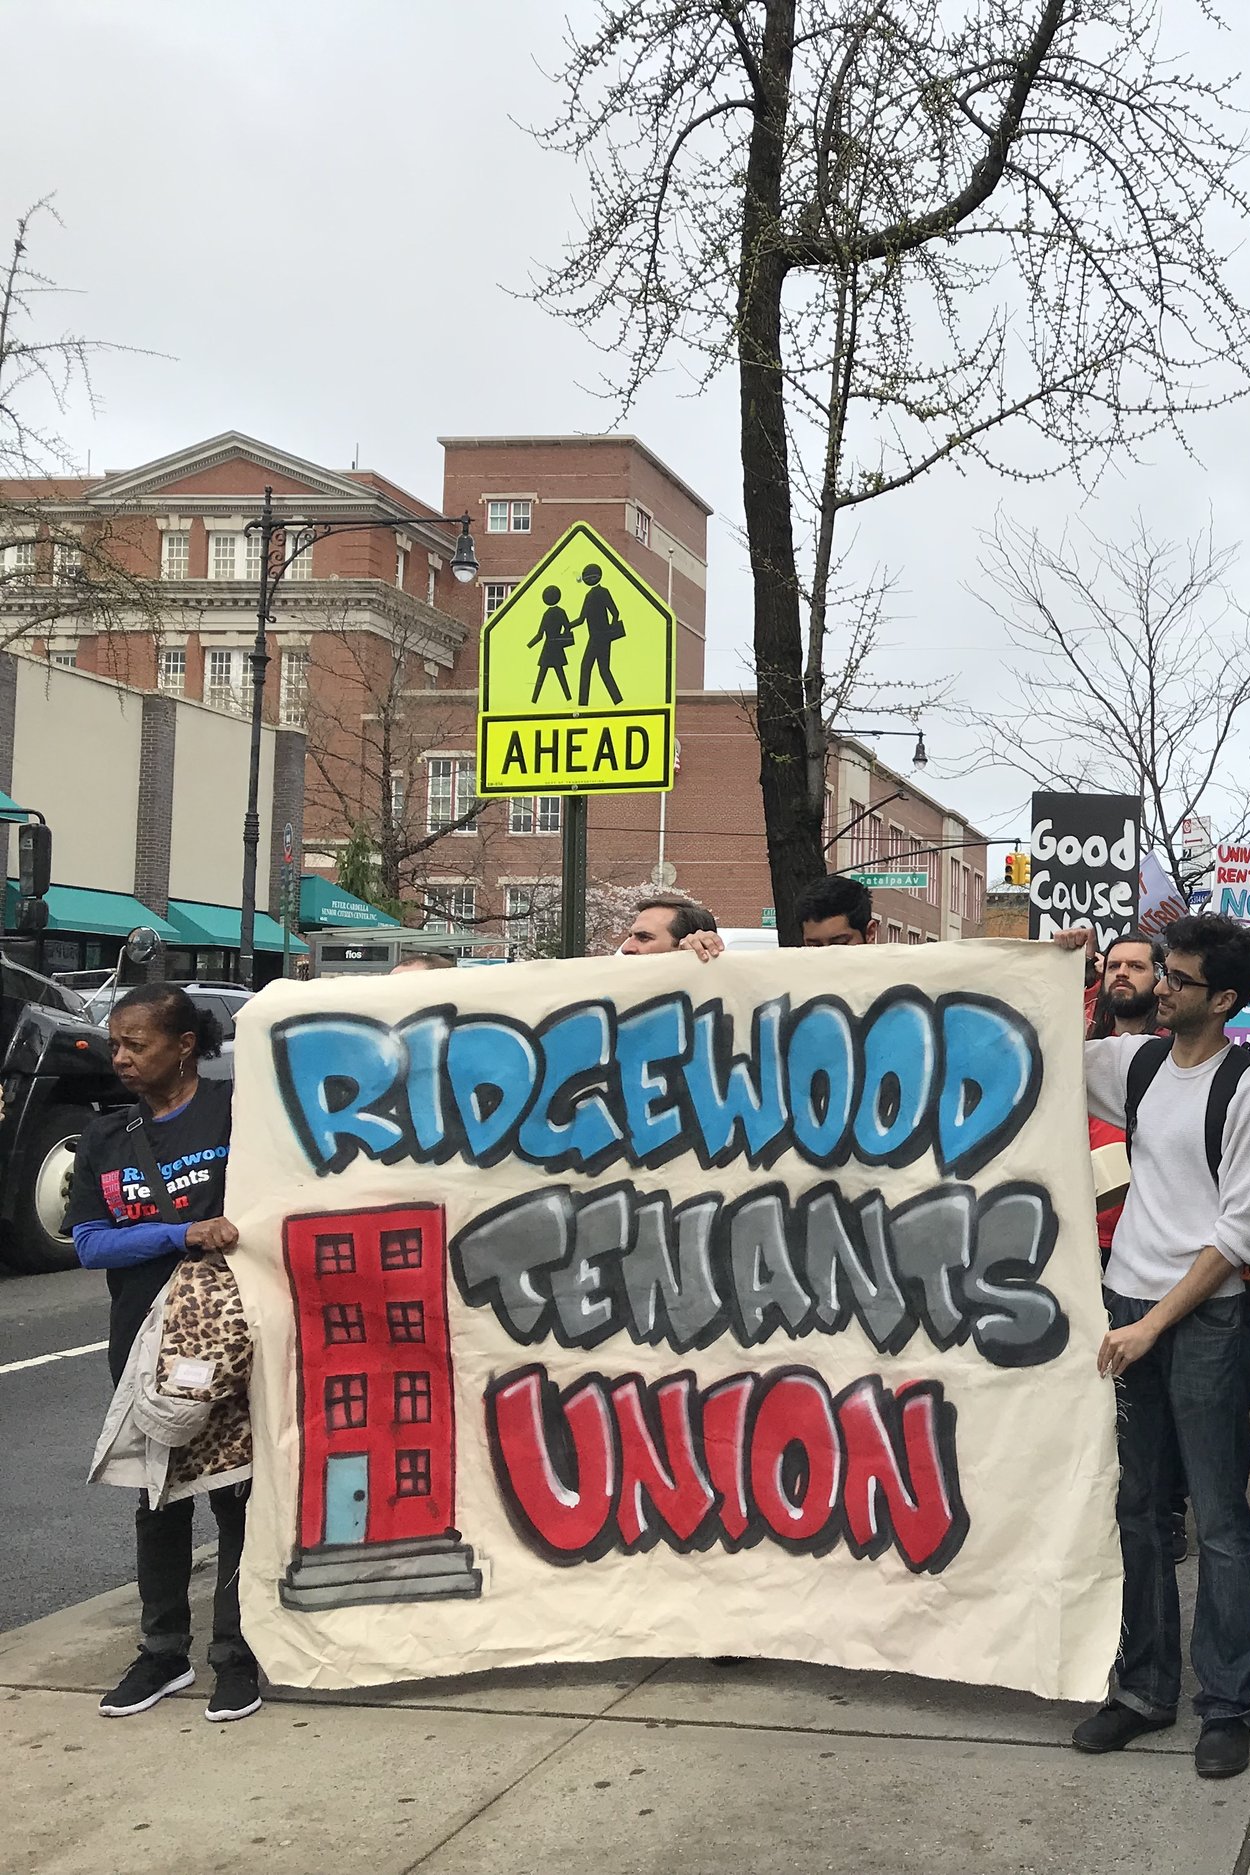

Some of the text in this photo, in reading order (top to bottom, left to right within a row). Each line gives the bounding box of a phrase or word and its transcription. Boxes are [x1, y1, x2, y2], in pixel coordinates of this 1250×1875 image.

[501, 726, 650, 774] AHEAD
[1031, 819, 1135, 871] Good
[858, 876, 920, 886] Catalpa Av
[1030, 870, 1134, 917] Cause
[345, 950, 362, 959] fios
[271, 985, 1043, 1176] RIDGEWOOD
[123, 1169, 210, 1200] Teants
[126, 1195, 190, 1220] Unn
[450, 1180, 1070, 1367] TENANTS
[484, 1366, 969, 1573] UNION
